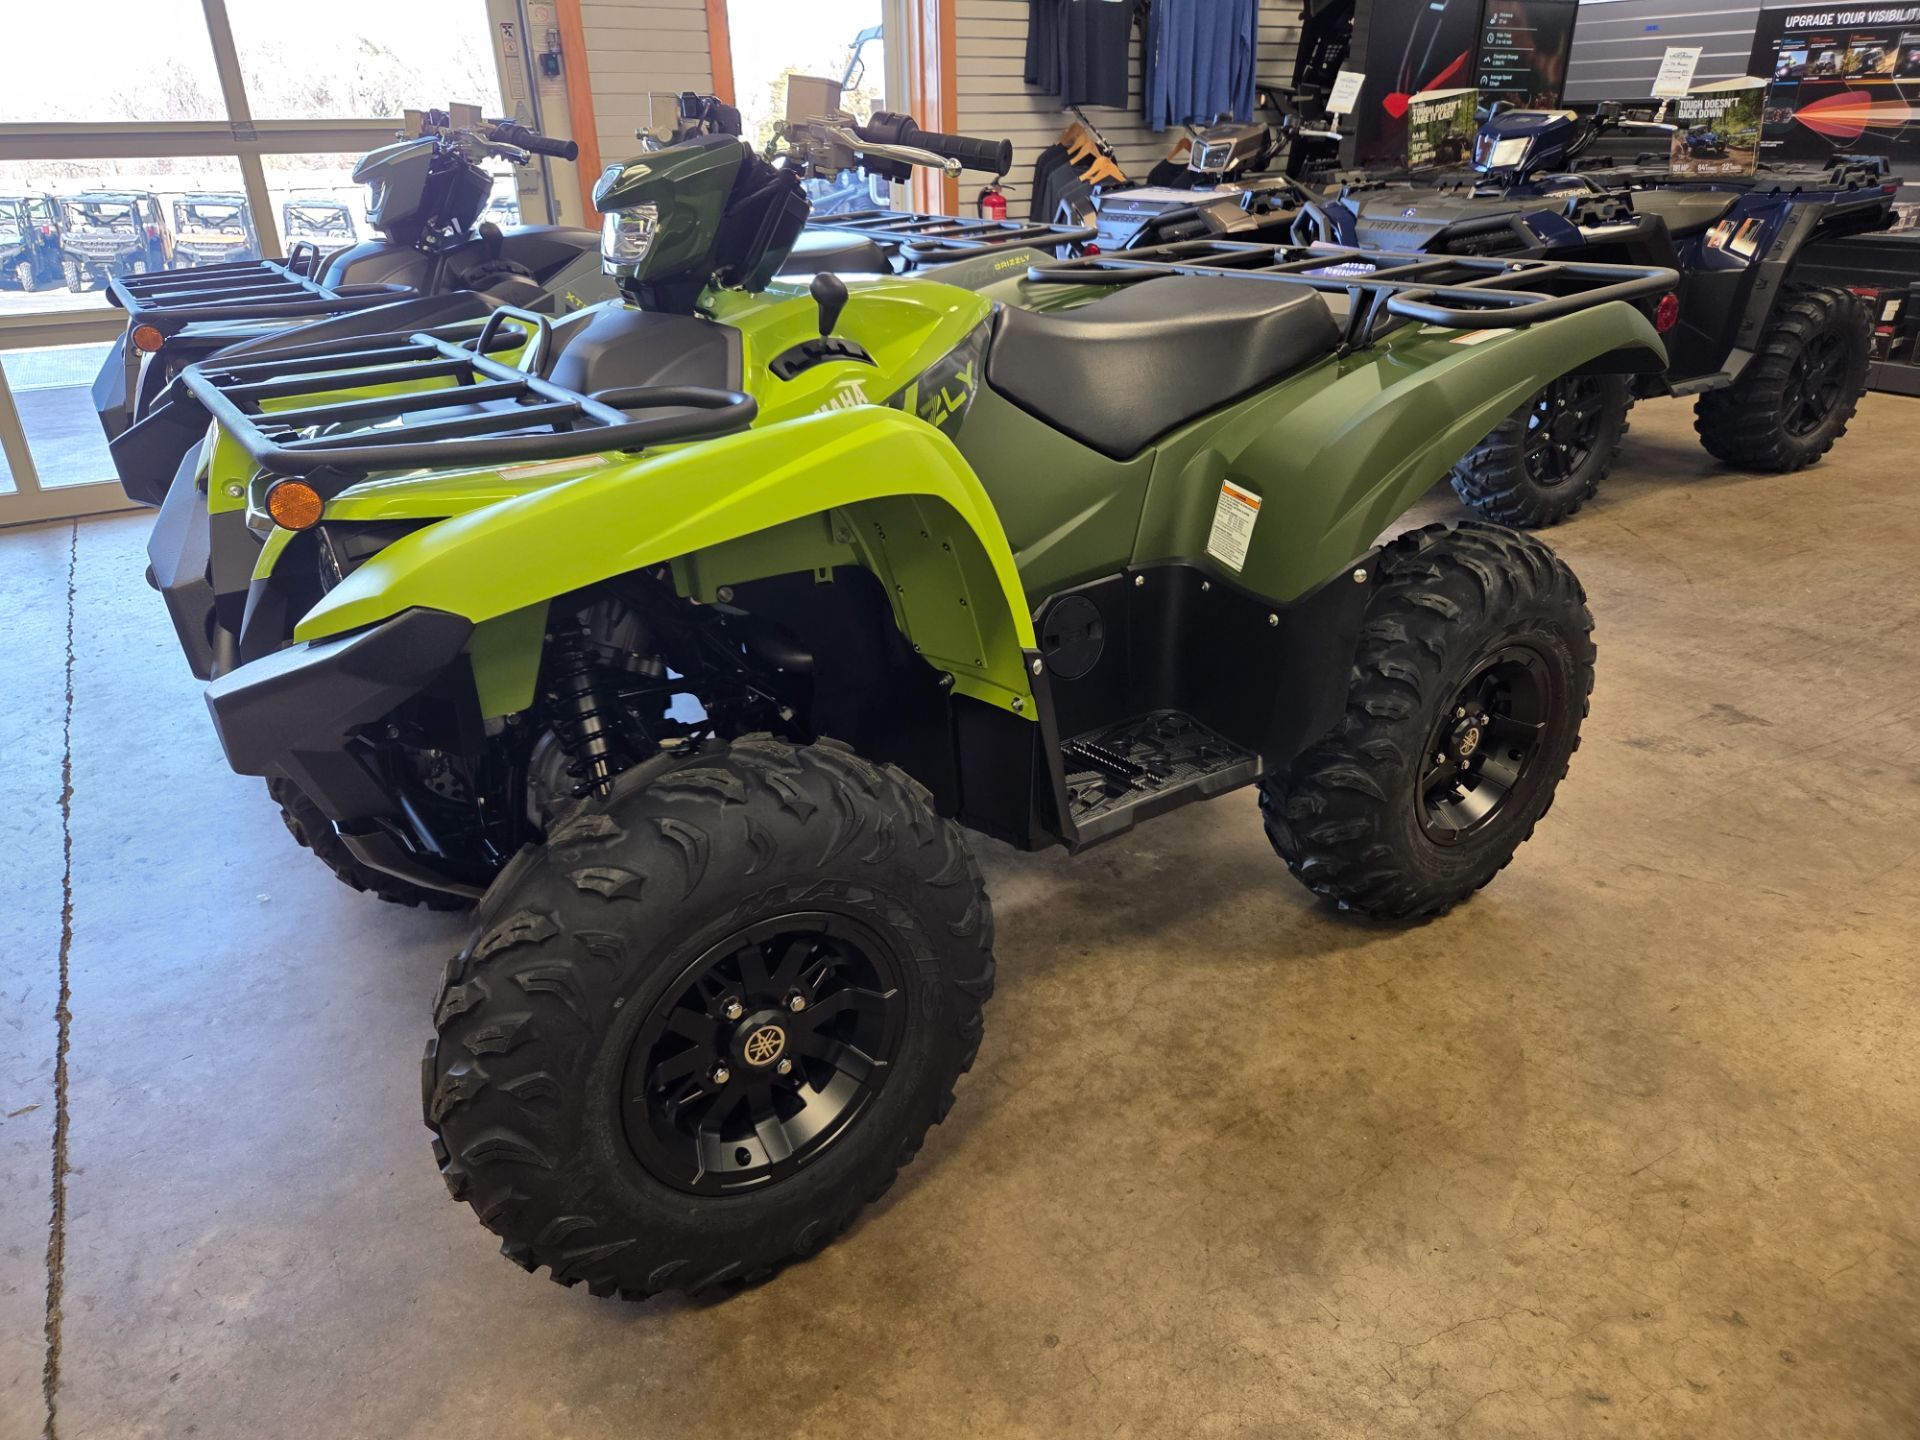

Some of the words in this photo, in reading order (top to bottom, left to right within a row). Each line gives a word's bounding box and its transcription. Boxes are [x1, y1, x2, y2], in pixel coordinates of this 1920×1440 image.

[1785, 13, 1835, 28] UPGRADE
[1836, 11, 1865, 25] YOUR
[1867, 7, 1920, 23] VISIBILIT
[1412, 104, 1434, 117] TOUGH
[1435, 99, 1462, 112] DOESN'T
[1679, 99, 1703, 109] TOUGH
[1704, 97, 1740, 108] DOESN'T
[1412, 113, 1429, 126] TAKE
[1430, 112, 1437, 122] IT
[1437, 110, 1455, 121] EASY
[1678, 109, 1698, 119] BACK
[1698, 108, 1723, 119] DOWN
[994, 253, 1030, 270] GRIZZLY
